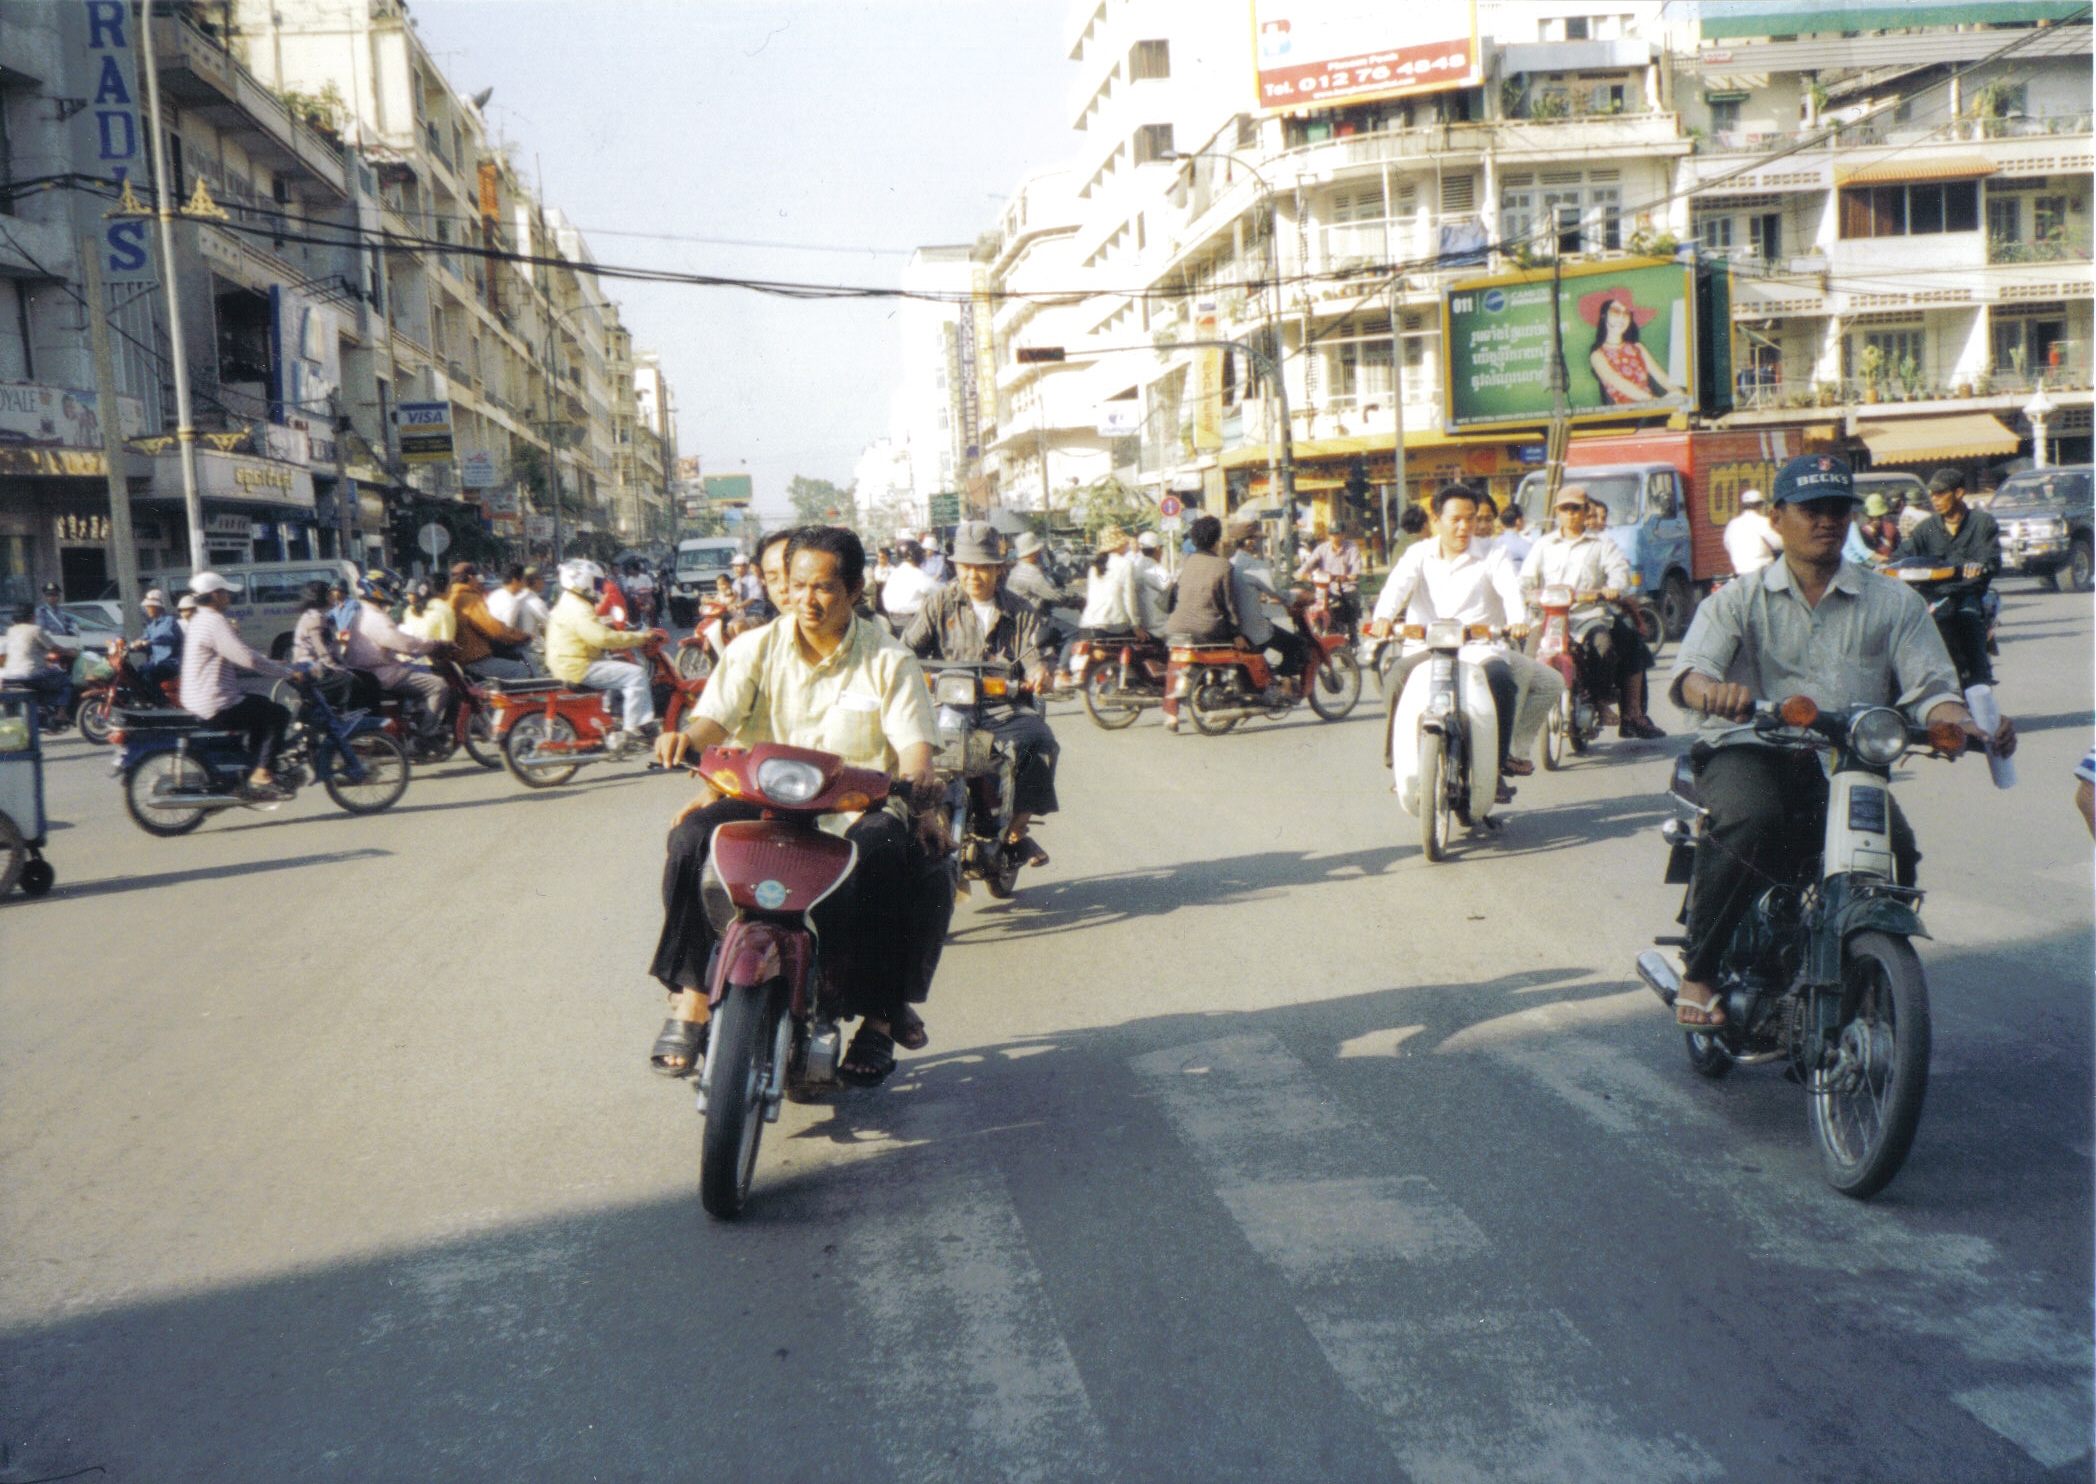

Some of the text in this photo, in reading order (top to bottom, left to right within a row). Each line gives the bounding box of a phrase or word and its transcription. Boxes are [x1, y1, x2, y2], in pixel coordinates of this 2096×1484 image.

[1265, 82, 1293, 97] Tel.
[1298, 72, 1348, 91] 012
[1355, 66, 1390, 82] 76
[408, 411, 444, 424] VISA
